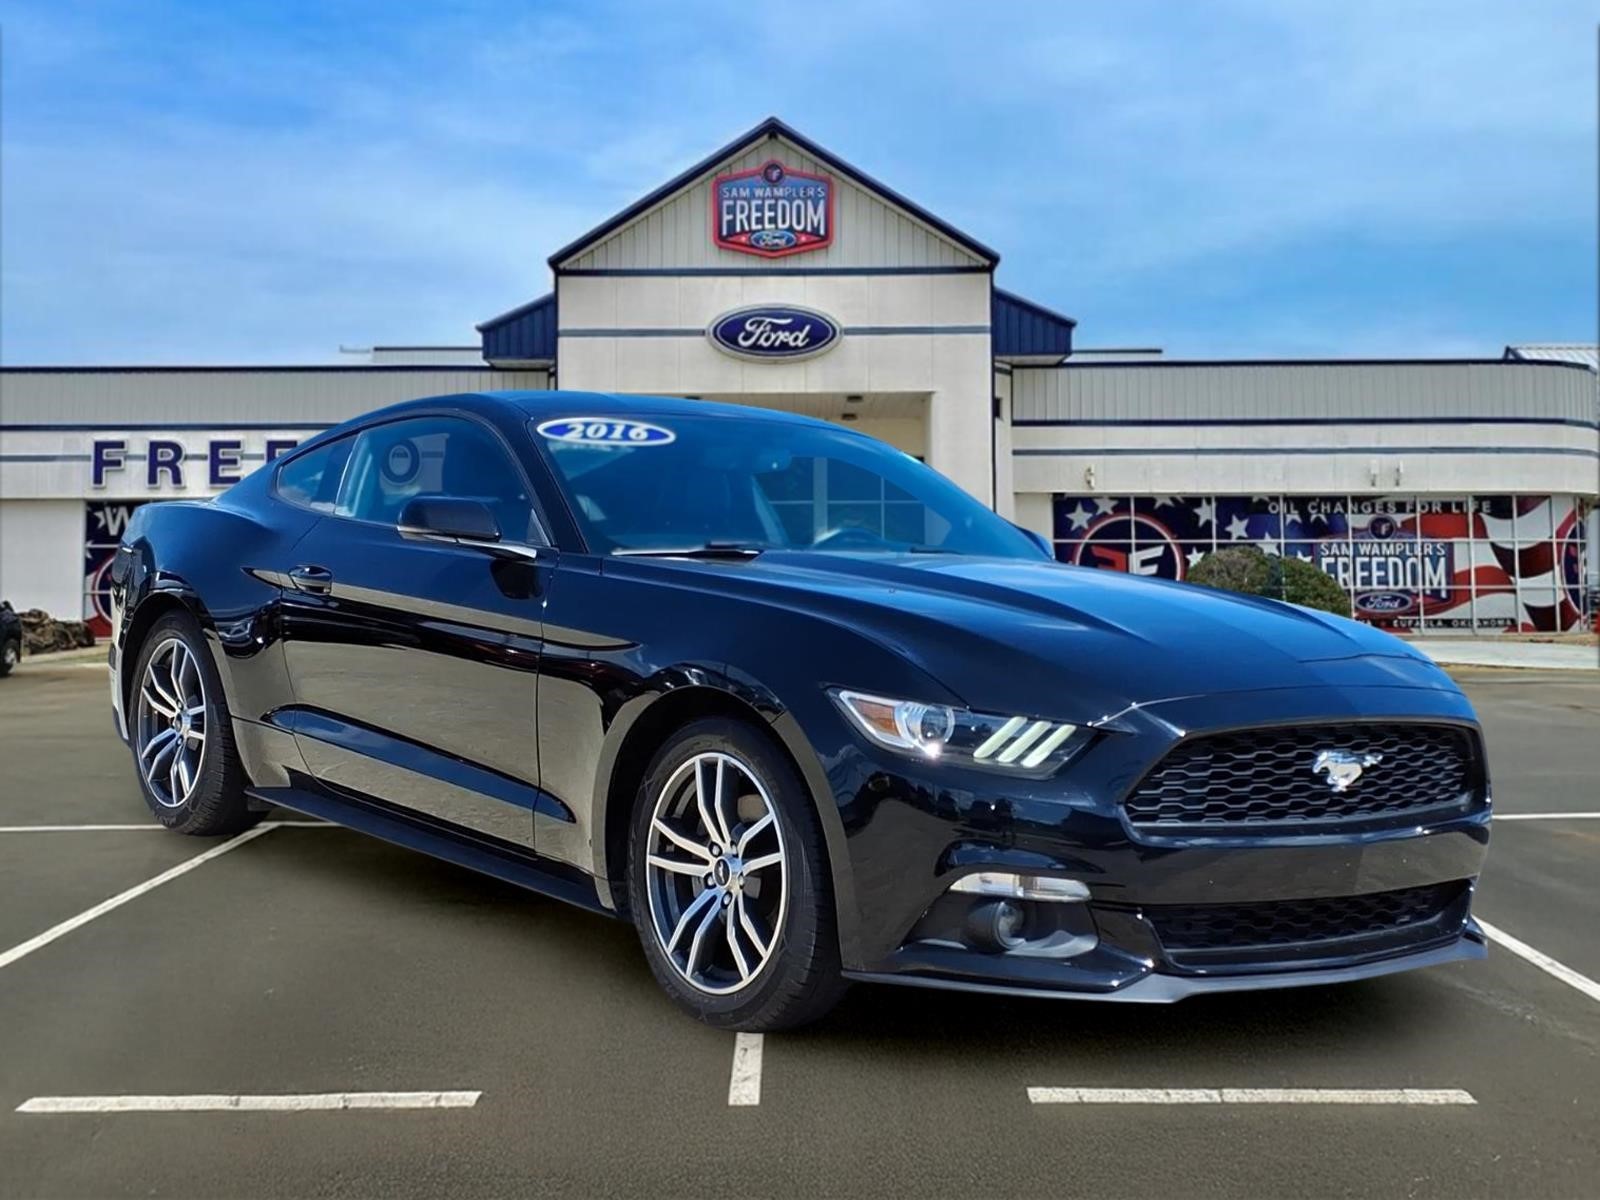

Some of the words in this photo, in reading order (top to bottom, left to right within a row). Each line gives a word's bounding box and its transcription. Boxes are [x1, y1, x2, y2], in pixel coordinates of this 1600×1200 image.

[722, 187, 750, 198] SAM
[722, 200, 826, 236] FREEDOM
[758, 234, 787, 247] Ford
[737, 317, 811, 347] Ford
[561, 422, 649, 441] 2016
[1268, 503, 1298, 514] OIL
[1308, 501, 1397, 514] CHANGES
[1405, 500, 1443, 513] FOR
[1452, 500, 1492, 514] LIFE
[1320, 543, 1352, 556] SAM
[1320, 556, 1448, 598] FREEDOM
[1365, 596, 1401, 609] Ford
